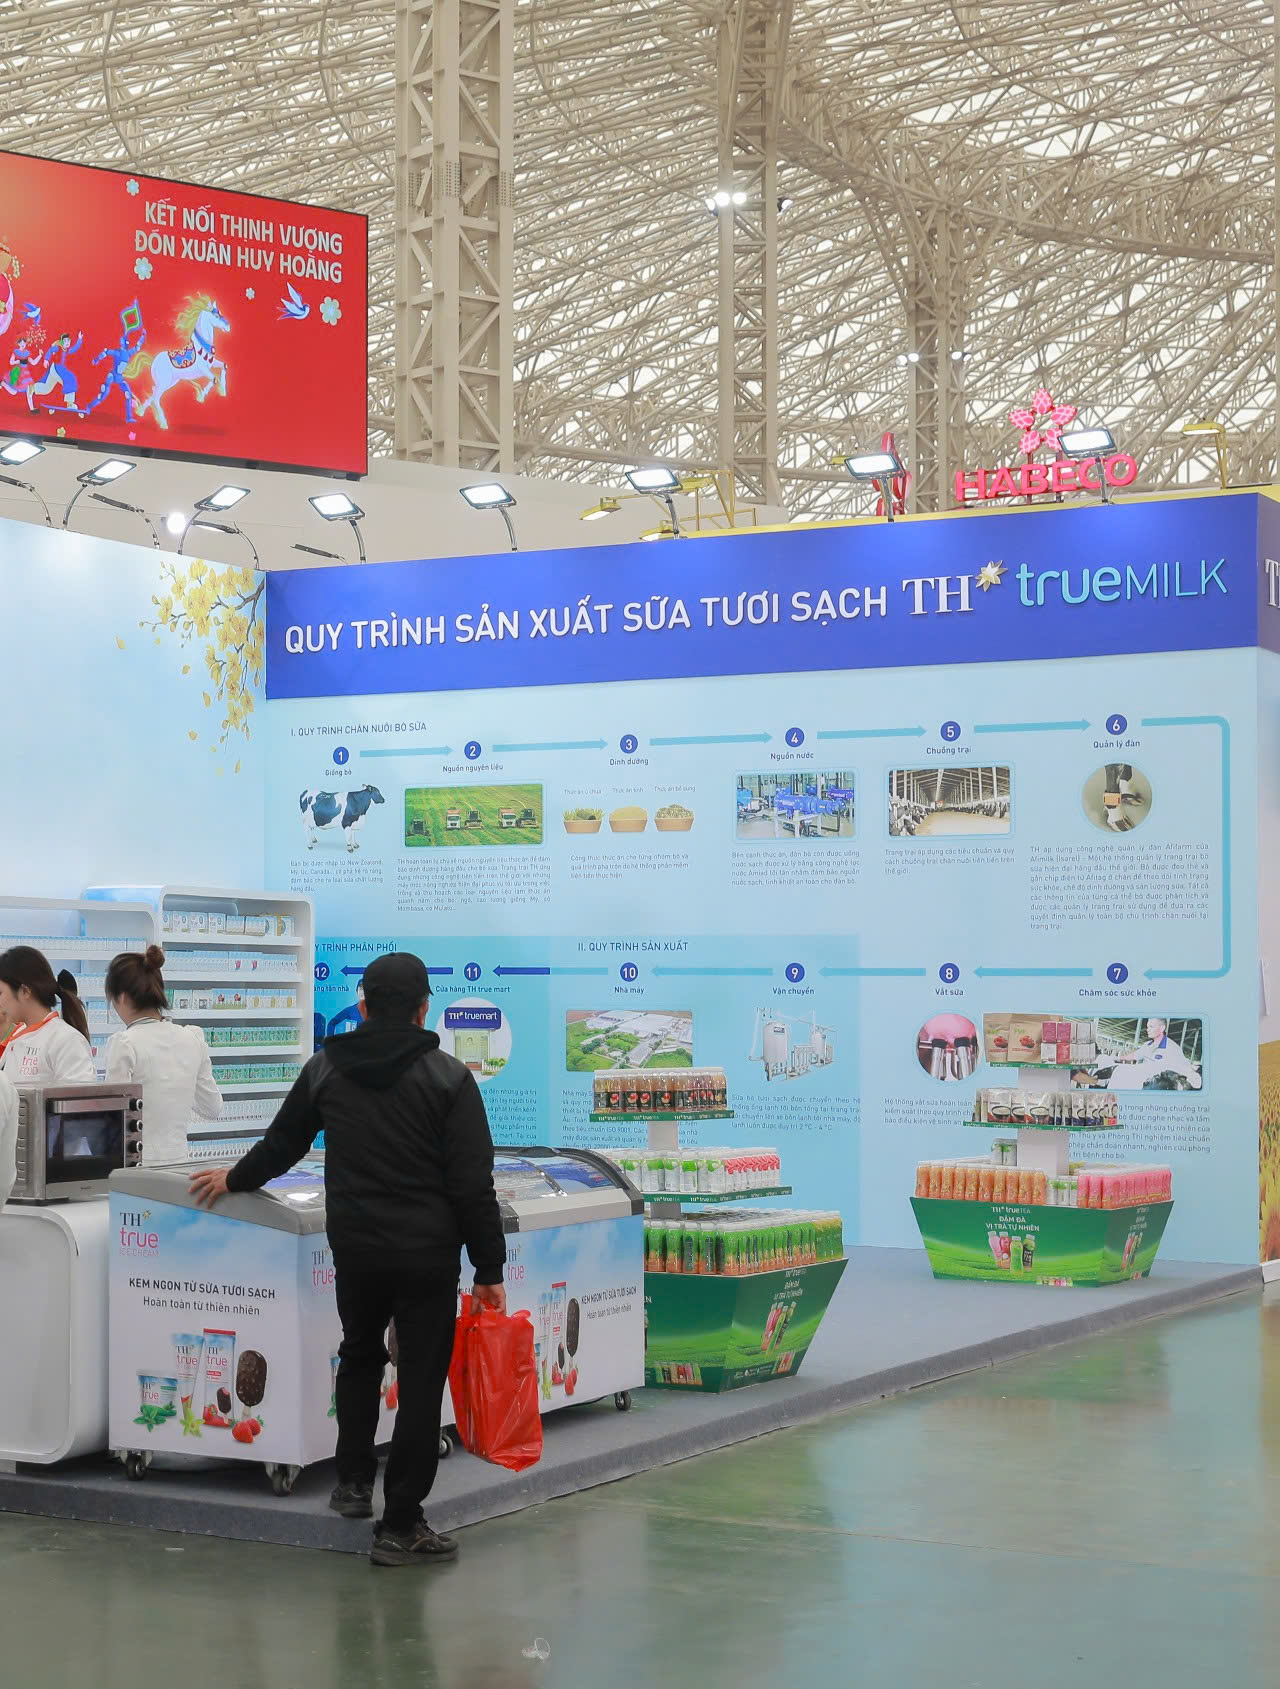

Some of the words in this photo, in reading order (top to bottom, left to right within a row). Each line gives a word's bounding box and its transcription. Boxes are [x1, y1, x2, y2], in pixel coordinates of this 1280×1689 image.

[145, 198, 176, 226] KẾT
[183, 205, 215, 233] NỐI
[221, 214, 273, 243] THỊNH
[280, 224, 343, 255] VƯỢNG
[135, 229, 175, 256] ĐÓN
[181, 237, 231, 266] XUÂN
[238, 247, 274, 272] HUY
[280, 254, 342, 283] HOÀNG
[955, 453, 1138, 502] HABECO
[285, 622, 344, 654] QUY
[351, 612, 445, 650] TRÌNH
[455, 603, 520, 644] SẢN
[530, 595, 614, 639] XUẤT
[623, 595, 691, 633] SỮA
[700, 590, 779, 628] TƯƠI
[791, 586, 887, 627] SẠCH
[902, 574, 974, 617] TH
[298, 727, 315, 737] QUY
[317, 725, 343, 736] TRÌNH
[371, 722, 392, 733] NUÔI
[394, 722, 406, 732] BÒ
[409, 722, 427, 732] SỮA
[947, 726, 954, 737] 5
[1112, 720, 1120, 731] 6
[626, 738, 632, 750] 3
[791, 732, 798, 744] 4
[1093, 740, 1114, 749] Quản
[1116, 739, 1123, 749] lý
[1125, 739, 1141, 748] đàn
[338, 751, 343, 762] 1
[469, 745, 476, 757] 2
[770, 751, 791, 761] Nguồn
[926, 745, 951, 757] Chuồng
[442, 763, 464, 773] Nguồn
[322, 941, 349, 952] TRÌNH
[350, 941, 374, 952] PHÂN
[376, 941, 397, 952] PHỐI
[578, 942, 586, 951] II.
[588, 942, 608, 952] QUY
[610, 941, 639, 951] TRÌNH
[642, 941, 661, 951] SẢN
[664, 940, 689, 951] XUẤT
[315, 967, 327, 978] 12
[466, 967, 478, 979] 11
[623, 967, 636, 979] 10
[791, 967, 799, 979] 9
[945, 968, 953, 978] 8
[1113, 968, 1121, 979] 7
[450, 985, 466, 994] hàng
[614, 986, 628, 994] Nhà
[629, 987, 644, 995] máy
[787, 987, 815, 996] chuyển
[1101, 988, 1117, 997] sóc
[1119, 988, 1135, 997] sức
[120, 1212, 141, 1227] TH
[1019, 1224, 1040, 1232] NHIÊN
[120, 1227, 158, 1248] true
[312, 1250, 325, 1265] TH
[508, 1249, 517, 1262] TH
[312, 1267, 334, 1286] true
[508, 1264, 524, 1280] true
[129, 1278, 150, 1288] KEM
[153, 1280, 181, 1291] NGON
[184, 1279, 197, 1292] TỪ
[199, 1281, 219, 1294] SỮA
[222, 1284, 245, 1296] TƯƠI
[248, 1288, 275, 1300] SẠCH
[143, 1296, 167, 1306] Hoàn
[170, 1299, 191, 1310] toàn
[194, 1300, 203, 1311] từ
[206, 1302, 230, 1312] thiên
[233, 1304, 260, 1315] nhiên
[207, 1355, 227, 1366] true
